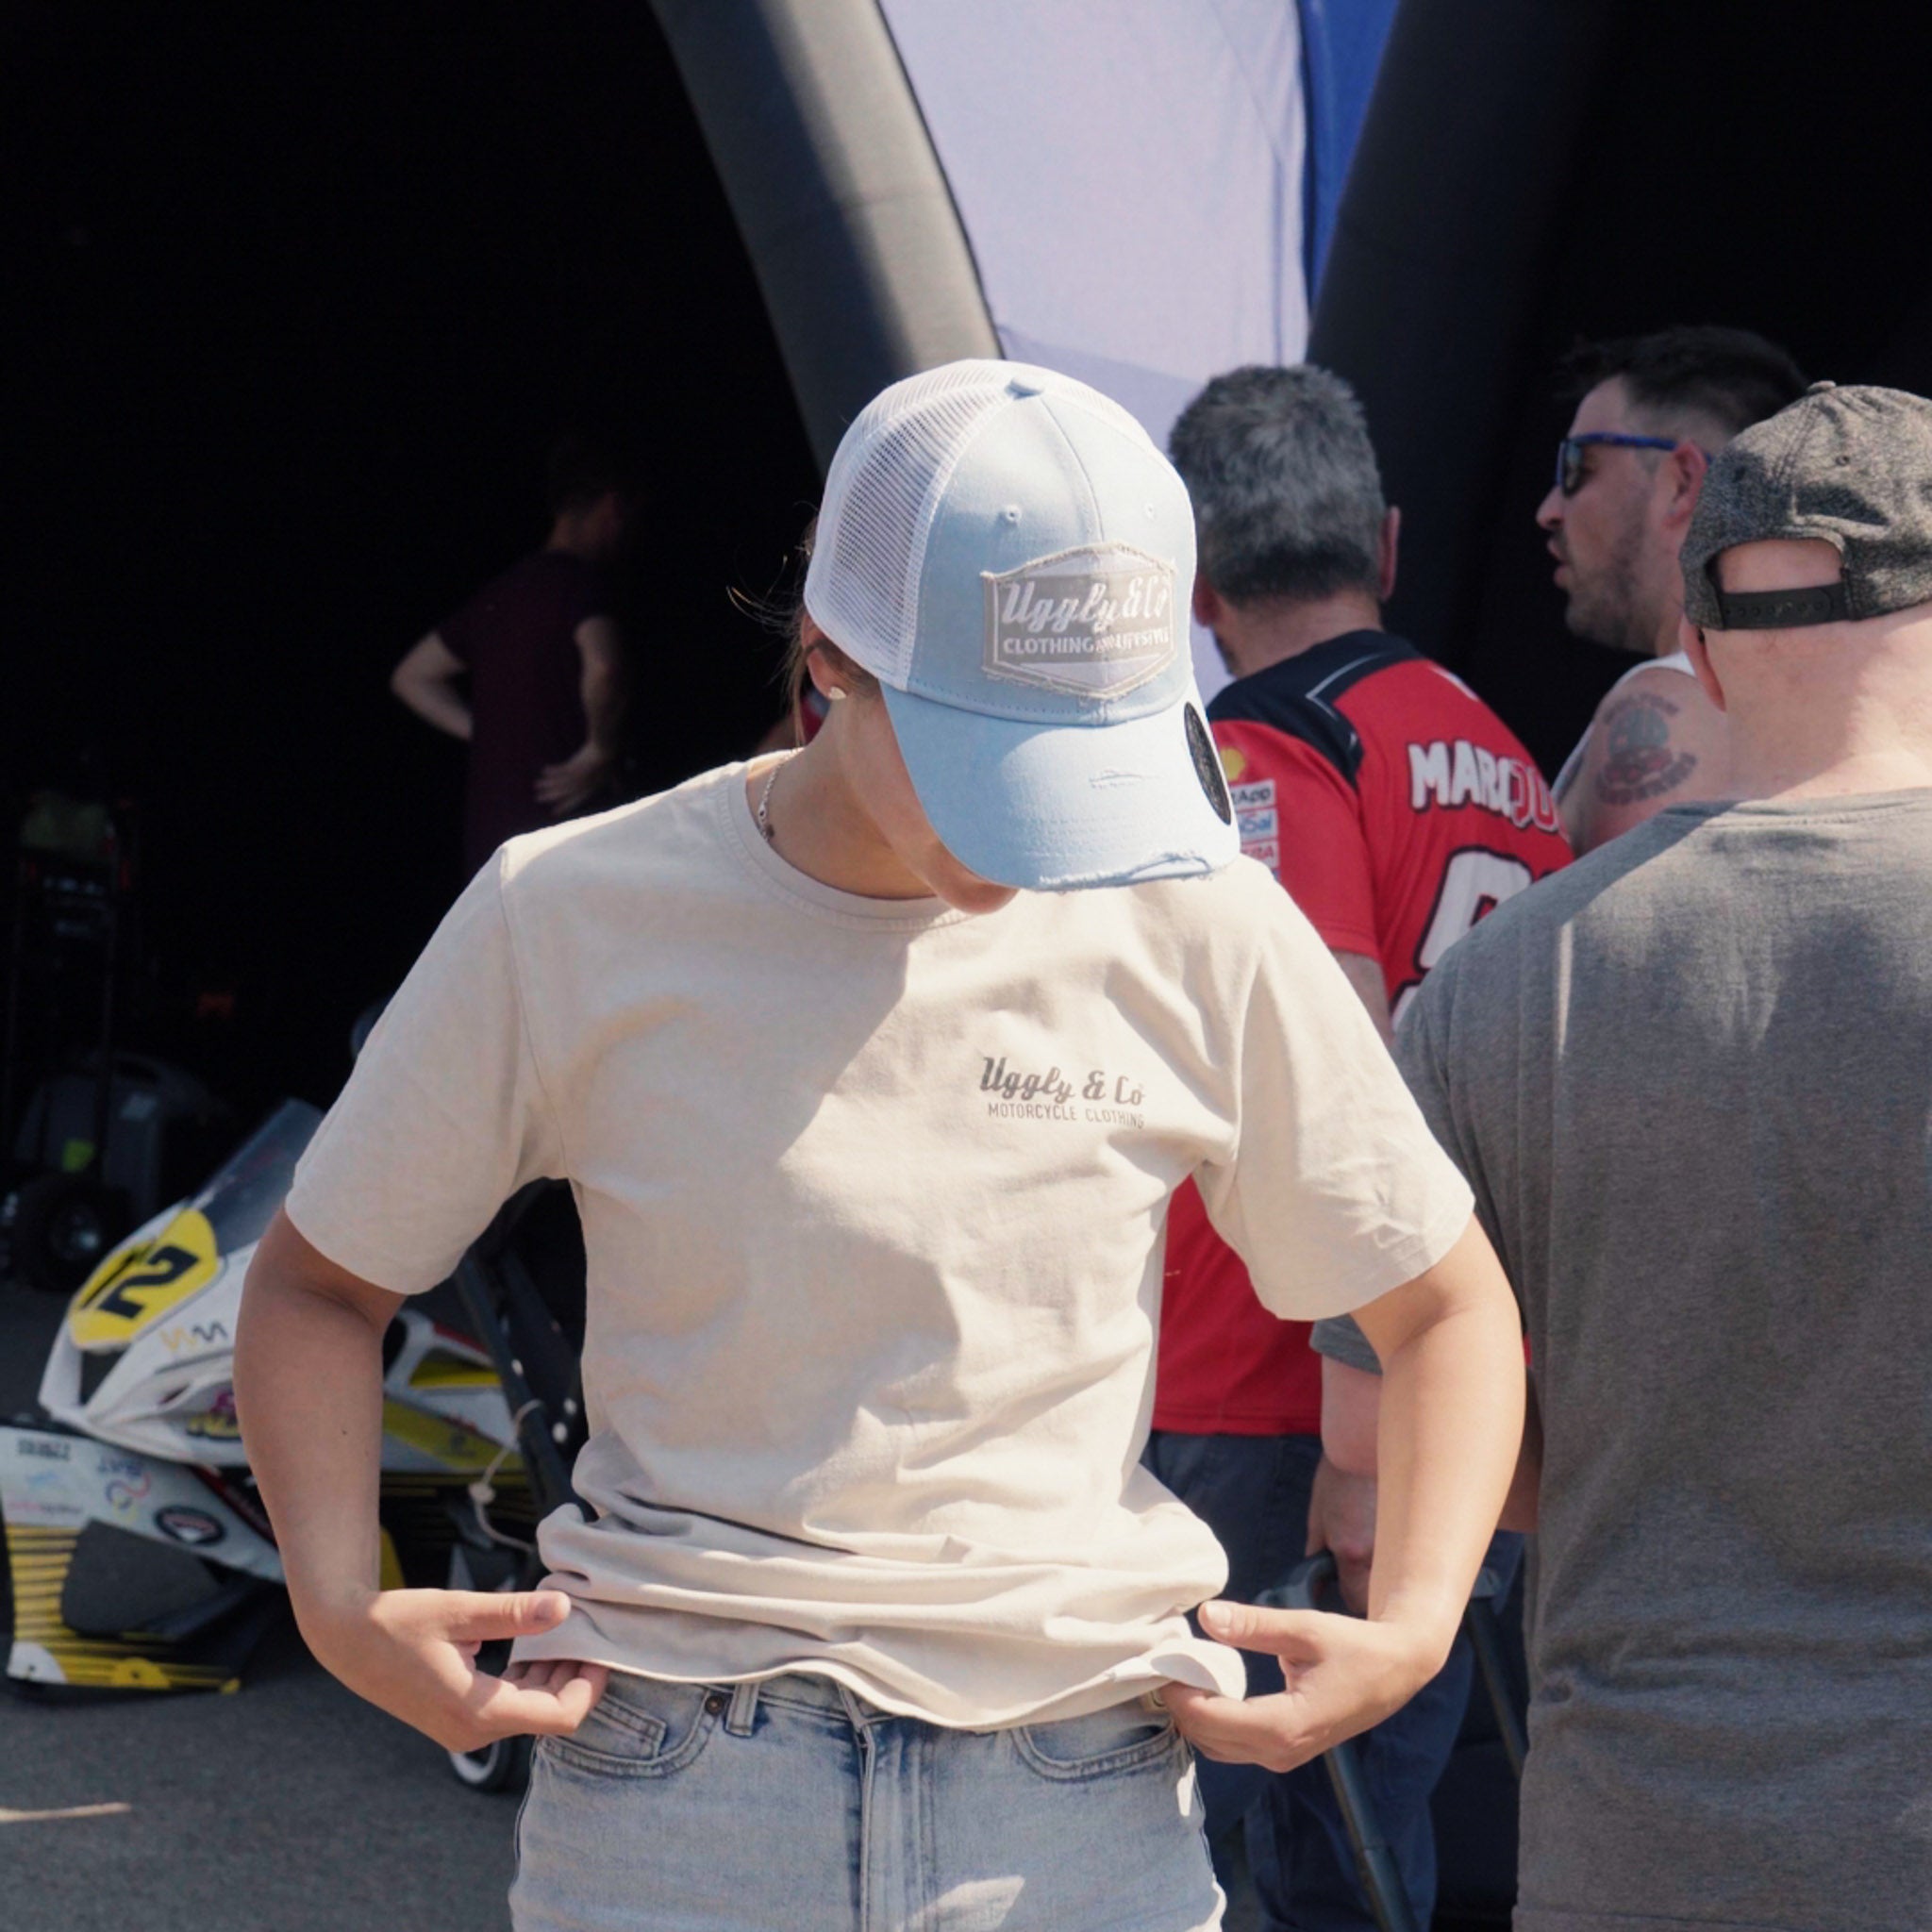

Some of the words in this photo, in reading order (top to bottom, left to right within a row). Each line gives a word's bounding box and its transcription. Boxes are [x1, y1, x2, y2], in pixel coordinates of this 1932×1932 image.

[1002, 581, 1120, 633] Uggly
[1004, 637, 1093, 655] CLOTHING
[1407, 740, 1562, 834] MARQU
[980, 1057, 1074, 1104] Uggly
[1082, 1070, 1106, 1101] &
[1114, 1075, 1144, 1106] Co
[988, 1102, 1077, 1121] MOTORCYCLE
[1085, 1108, 1144, 1129] CLOTHING
